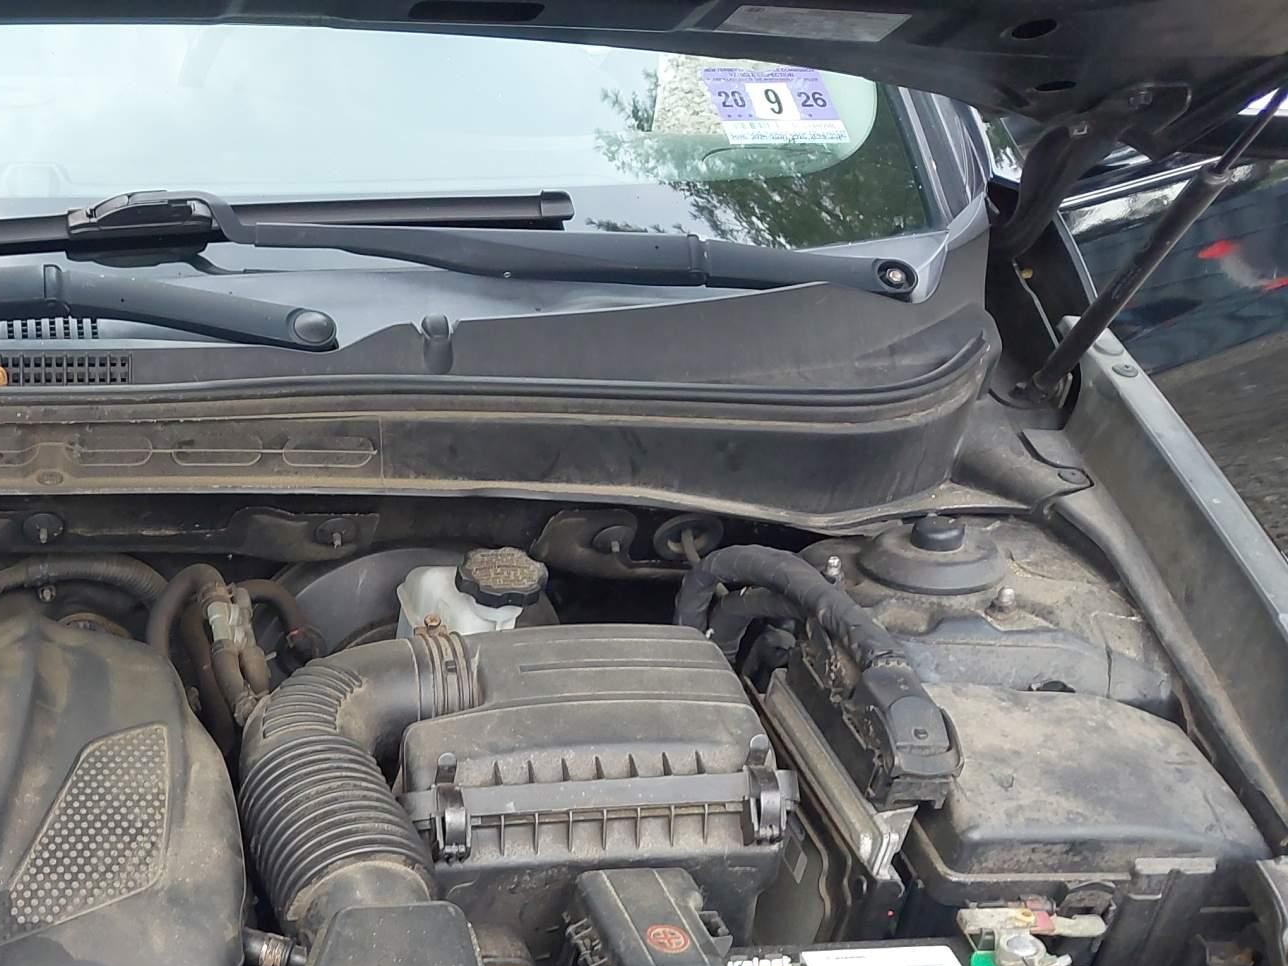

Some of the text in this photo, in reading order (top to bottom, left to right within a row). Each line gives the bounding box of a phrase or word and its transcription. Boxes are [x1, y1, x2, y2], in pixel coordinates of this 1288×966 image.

[717, 88, 828, 115] 20 9 26
